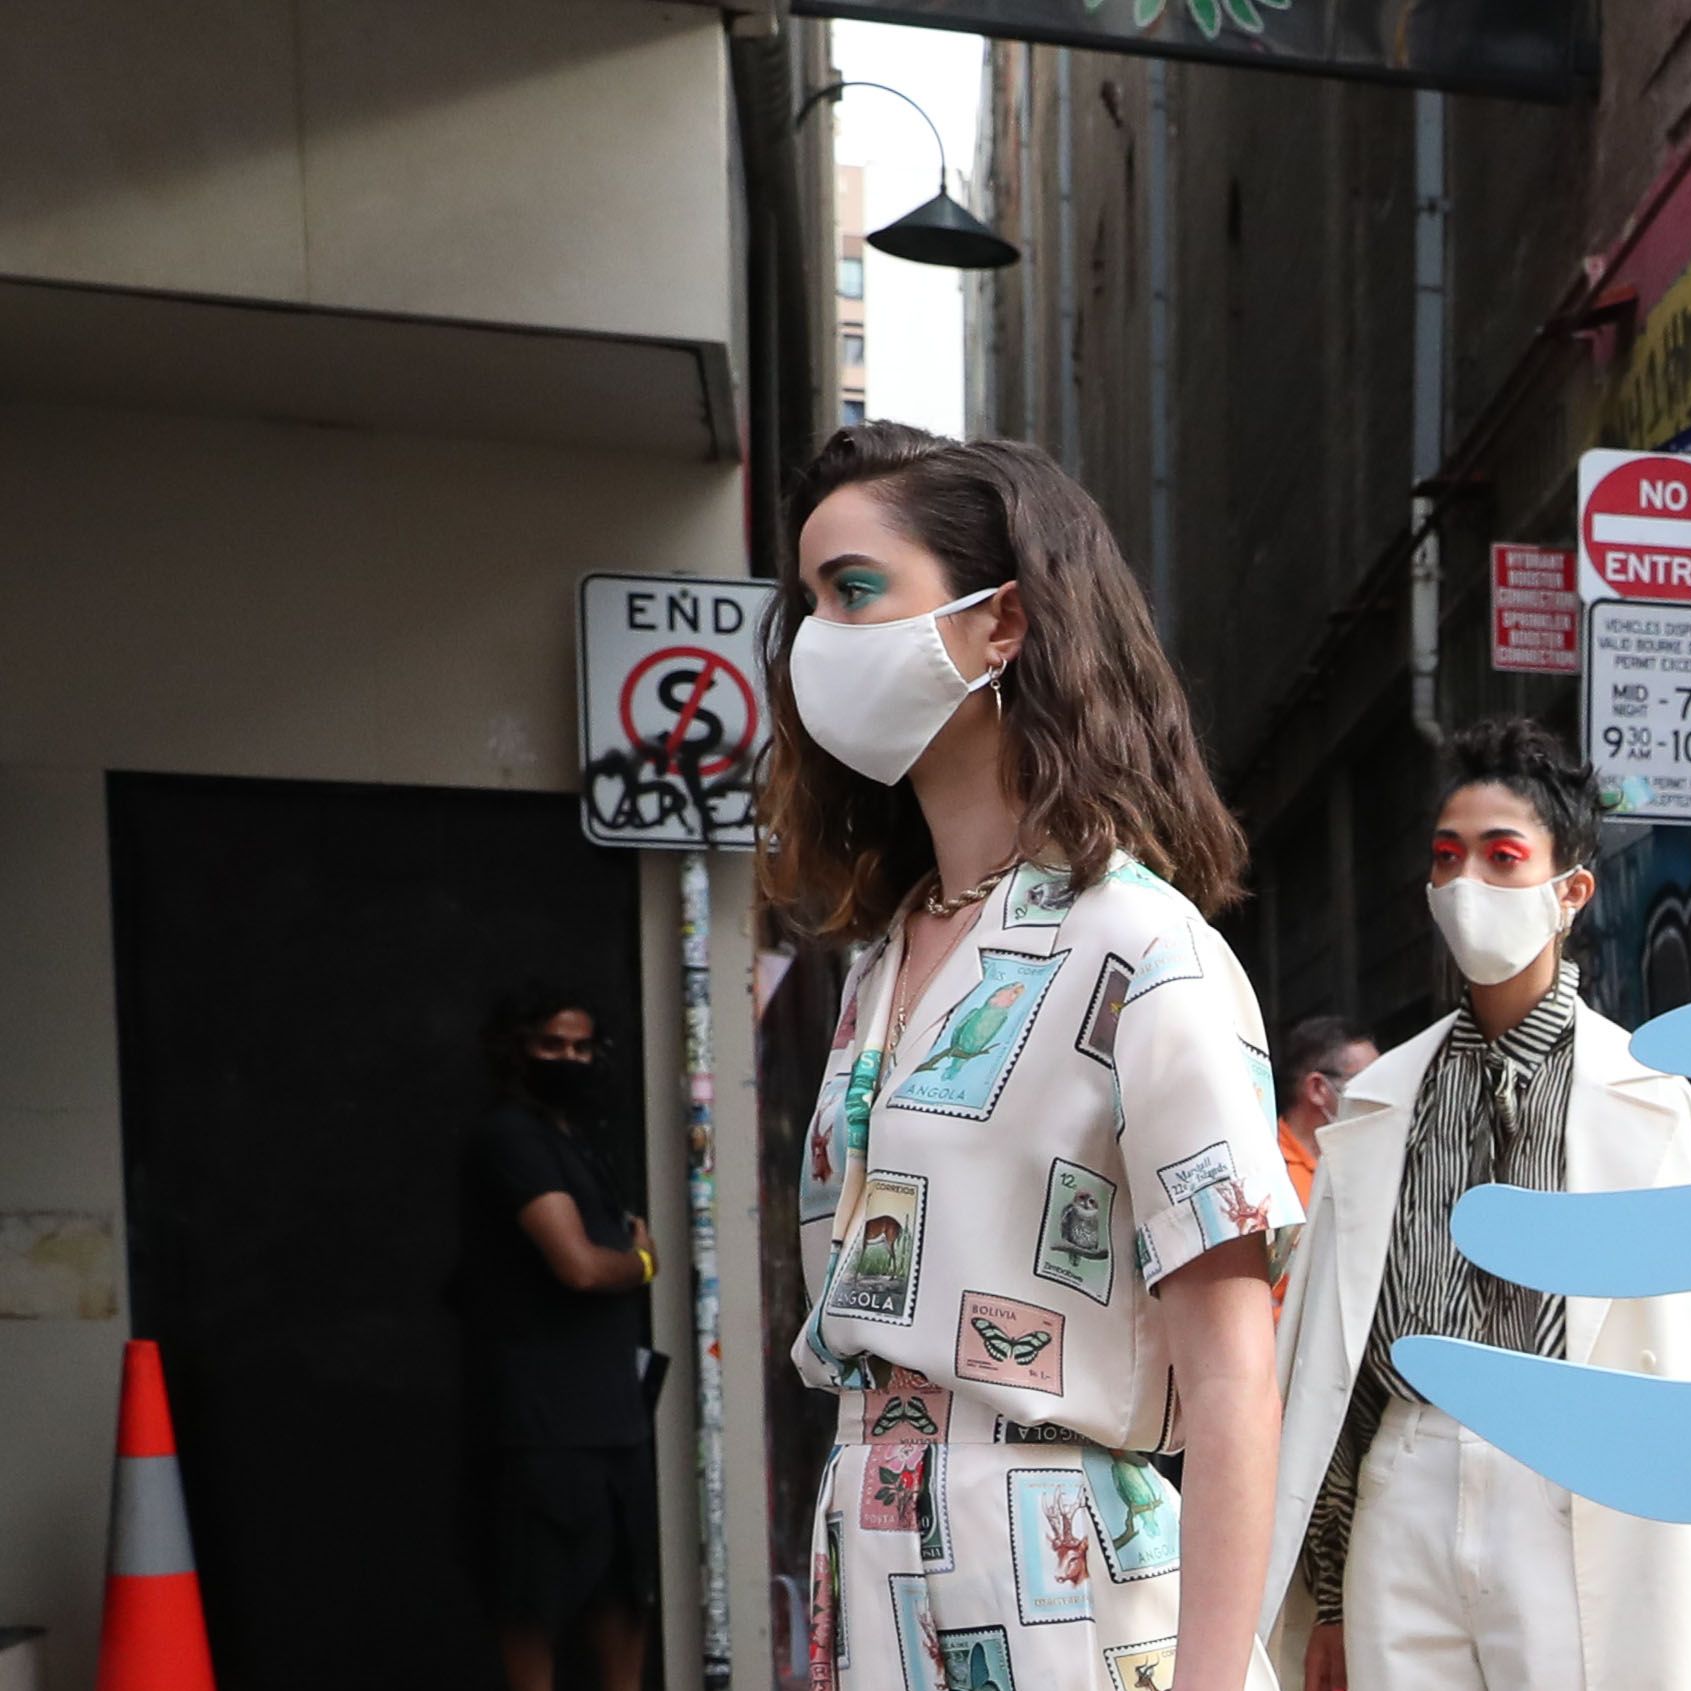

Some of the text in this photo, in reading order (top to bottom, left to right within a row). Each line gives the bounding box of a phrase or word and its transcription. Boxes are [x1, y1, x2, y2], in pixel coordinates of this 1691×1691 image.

[1639, 478, 1688, 512] NO
[627, 593, 743, 634] END
[1614, 653, 1657, 669] PERMIT
[1613, 684, 1648, 702] MID
[1603, 726, 1652, 758] 9 30
[1627, 748, 1652, 759] AM
[907, 1085, 966, 1100] ANGOLA
[875, 1182, 916, 1196] CORREIOS
[971, 1305, 1017, 1321] BOLIVIA
[1136, 1544, 1176, 1564] ANGO
